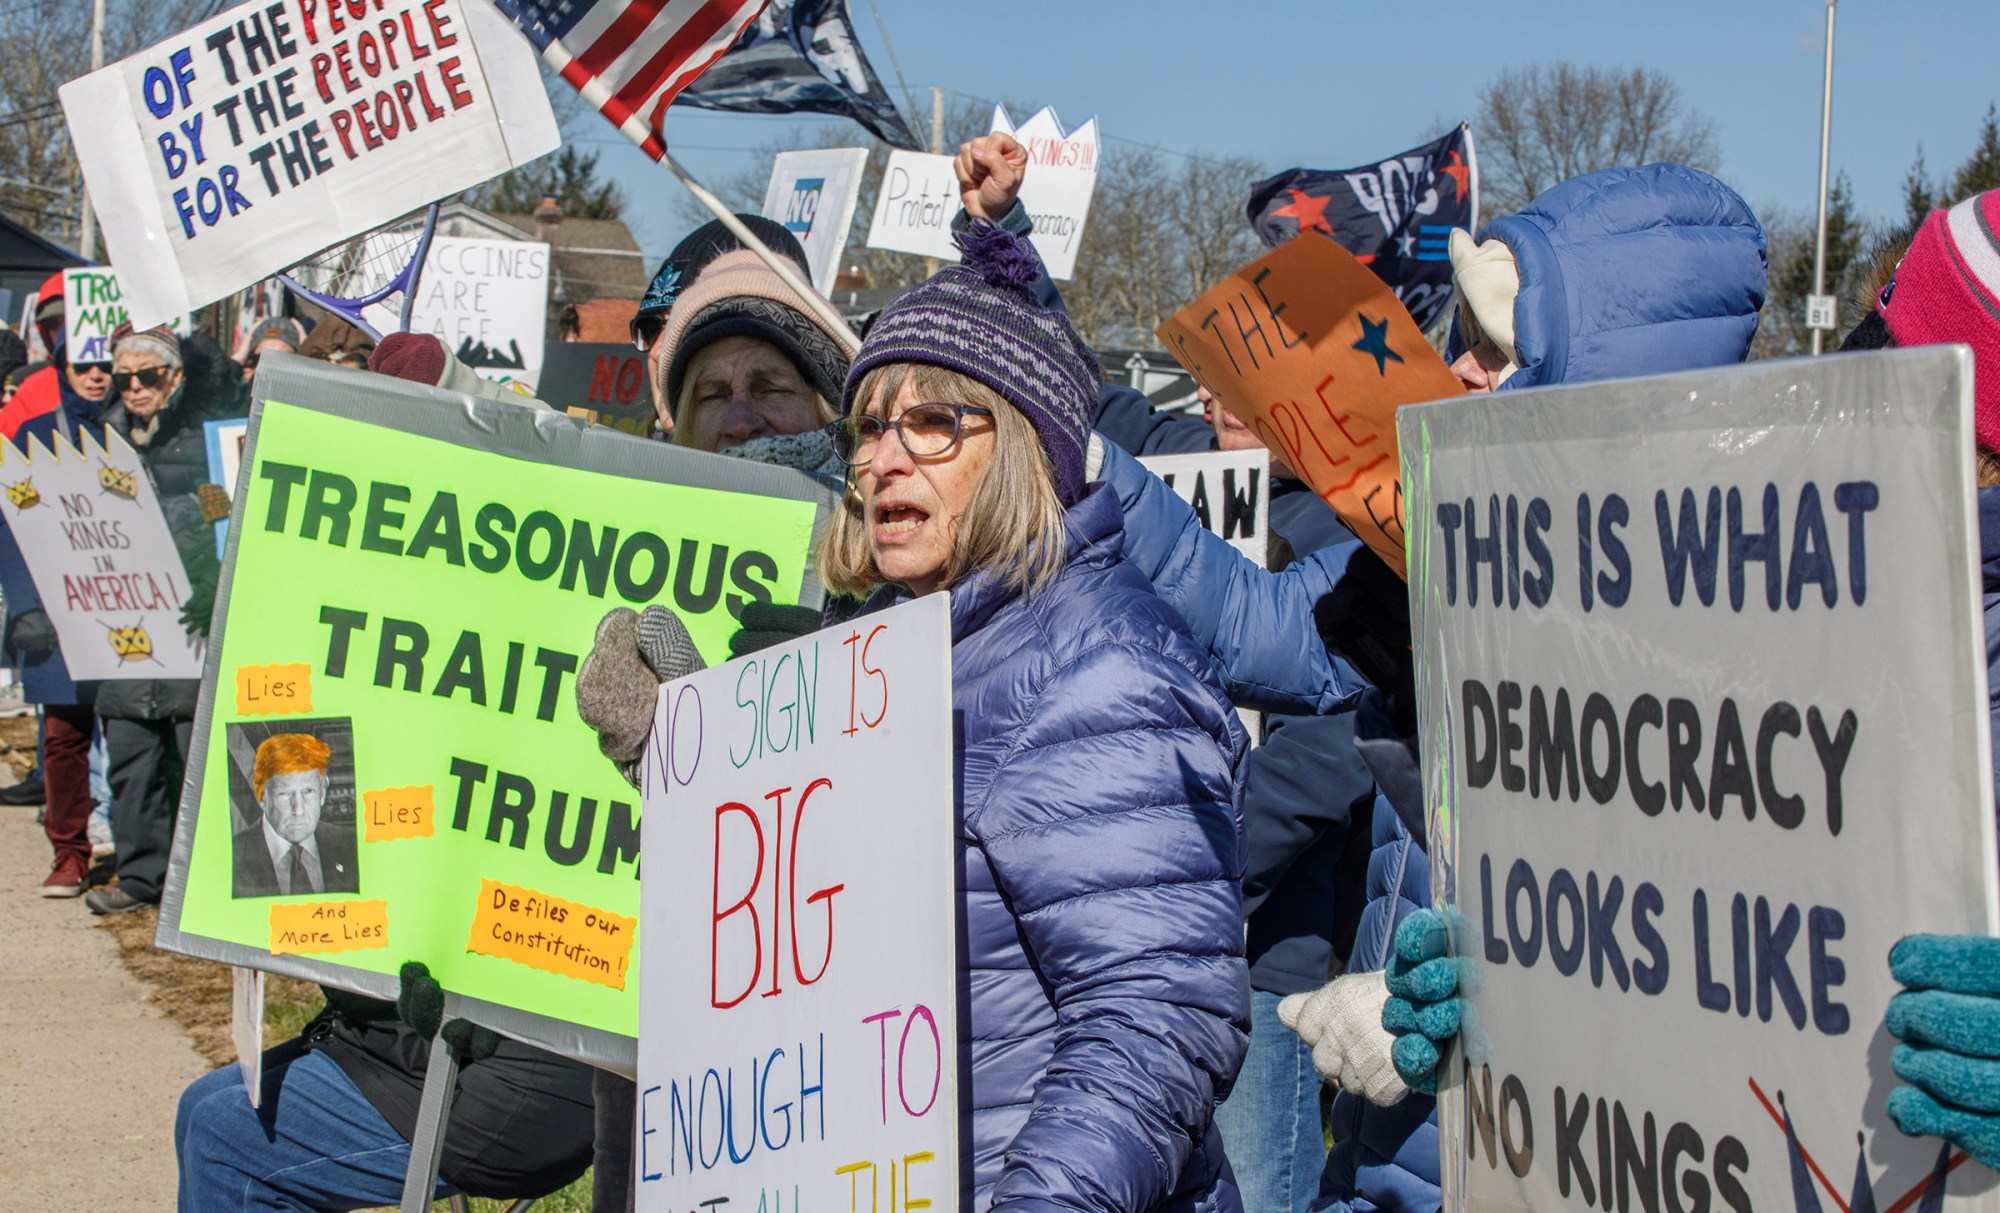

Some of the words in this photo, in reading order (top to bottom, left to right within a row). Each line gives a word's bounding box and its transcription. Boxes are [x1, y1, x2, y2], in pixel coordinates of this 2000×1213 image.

[143, 46, 197, 120] OF
[206, 1, 298, 86] THE
[157, 112, 206, 180] BY
[213, 67, 304, 147] THE
[310, 0, 459, 104] PEOPLE
[173, 165, 253, 240] FOR
[249, 119, 334, 197] THE
[330, 56, 474, 160] PEOPLE
[1028, 135, 1094, 171] KINGS!!!
[785, 189, 820, 224] NO
[883, 167, 951, 230] Protect
[68, 272, 122, 306] TRO
[388, 242, 546, 280] VCCINES
[426, 280, 489, 312] ARE
[1201, 267, 1308, 377] THE
[588, 354, 645, 405] NO
[1256, 374, 1378, 488] OPLE
[59, 493, 93, 519] NO
[60, 520, 130, 551] KINGS
[1164, 467, 1260, 540] AW
[92, 554, 116, 573] IN
[259, 460, 779, 620] TREASONOUS
[1437, 492, 1555, 611] THIS
[1576, 491, 1632, 614] IS
[1654, 480, 1880, 613] WHAT
[247, 674, 297, 702] Lies
[319, 605, 579, 723] TRAIT
[645, 684, 703, 800] NO
[728, 641, 819, 769] SIGN
[841, 624, 888, 738] IS
[1461, 679, 1858, 837] DEMOCRACY
[373, 800, 423, 826] Lies
[449, 756, 641, 881] TRUM
[311, 904, 346, 920] And
[493, 889, 569, 923] Defiles
[585, 914, 620, 936] our
[711, 777, 845, 1009] BIG
[278, 930, 334, 946] More
[343, 922, 382, 940] Lies
[492, 922, 624, 978] Constitution!
[1480, 853, 1669, 996] LOOKS
[1692, 888, 1851, 1036] LIKE
[642, 1032, 825, 1183] ENOUGH
[861, 1004, 941, 1126] TO
[1463, 1056, 1534, 1179] NO
[1554, 1084, 1754, 1213] KINGS
